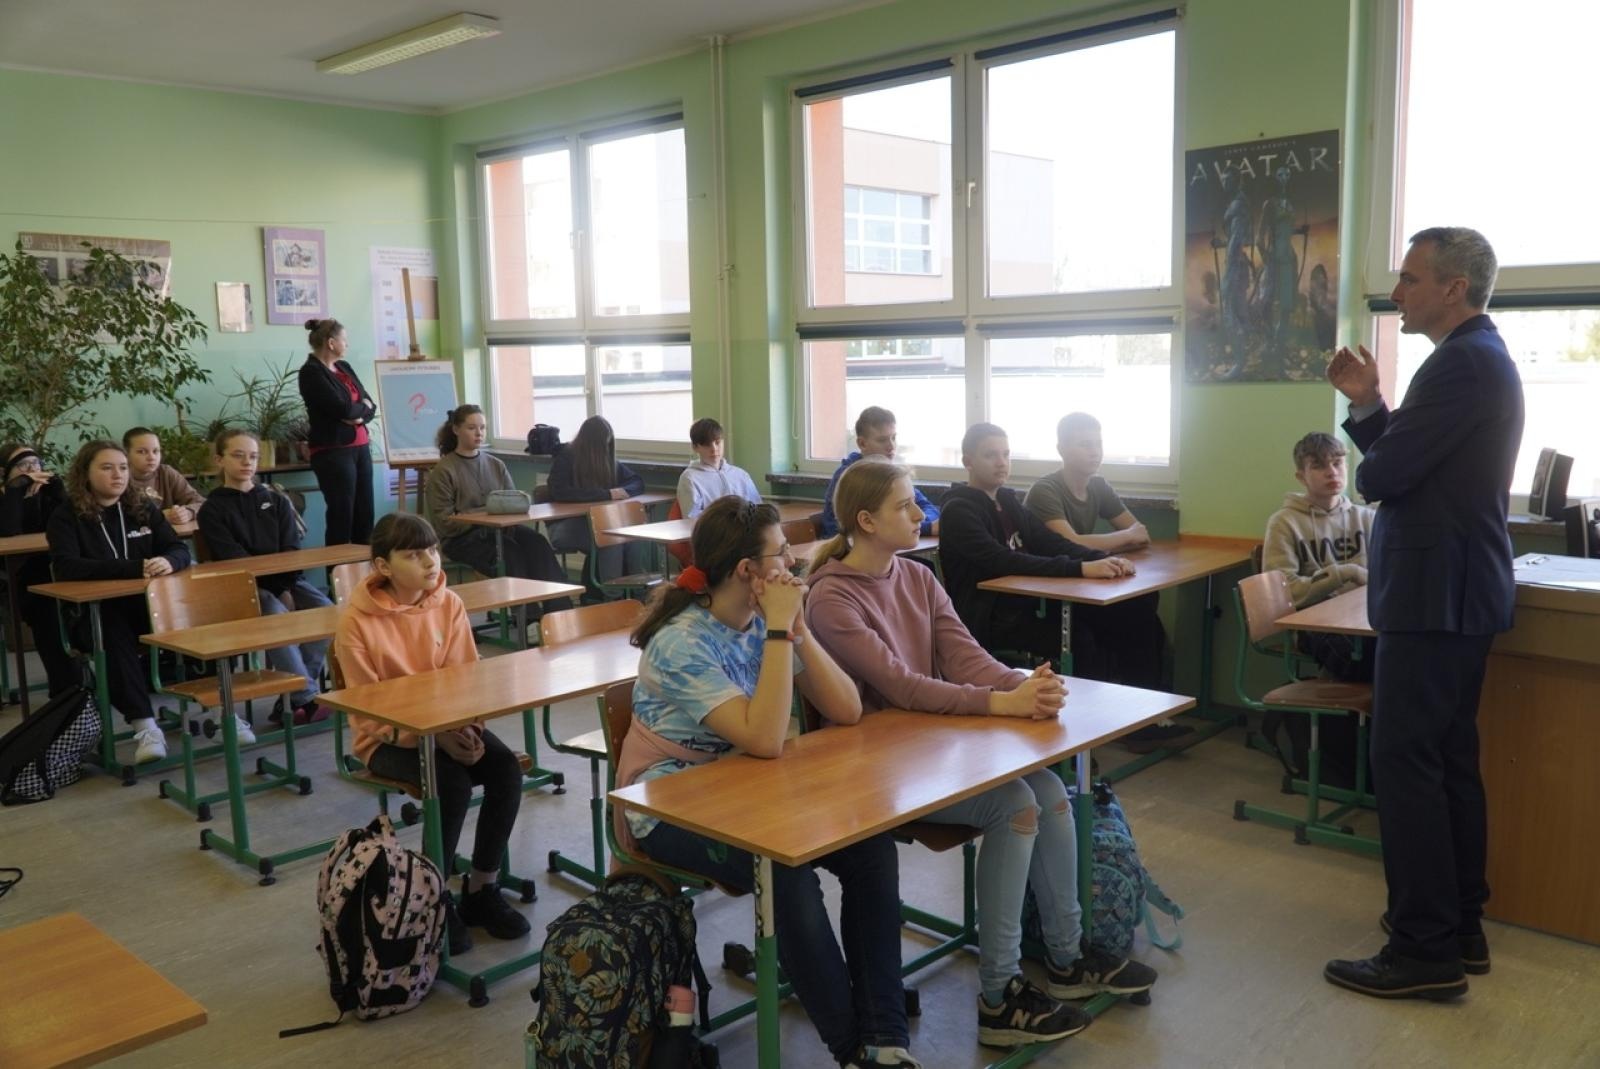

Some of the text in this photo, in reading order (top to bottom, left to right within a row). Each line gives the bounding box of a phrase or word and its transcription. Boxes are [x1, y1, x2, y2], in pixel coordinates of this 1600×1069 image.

[1190, 147, 1333, 189] AVATAR
[1081, 970, 1102, 985] N
[1009, 1008, 1031, 1030] N
